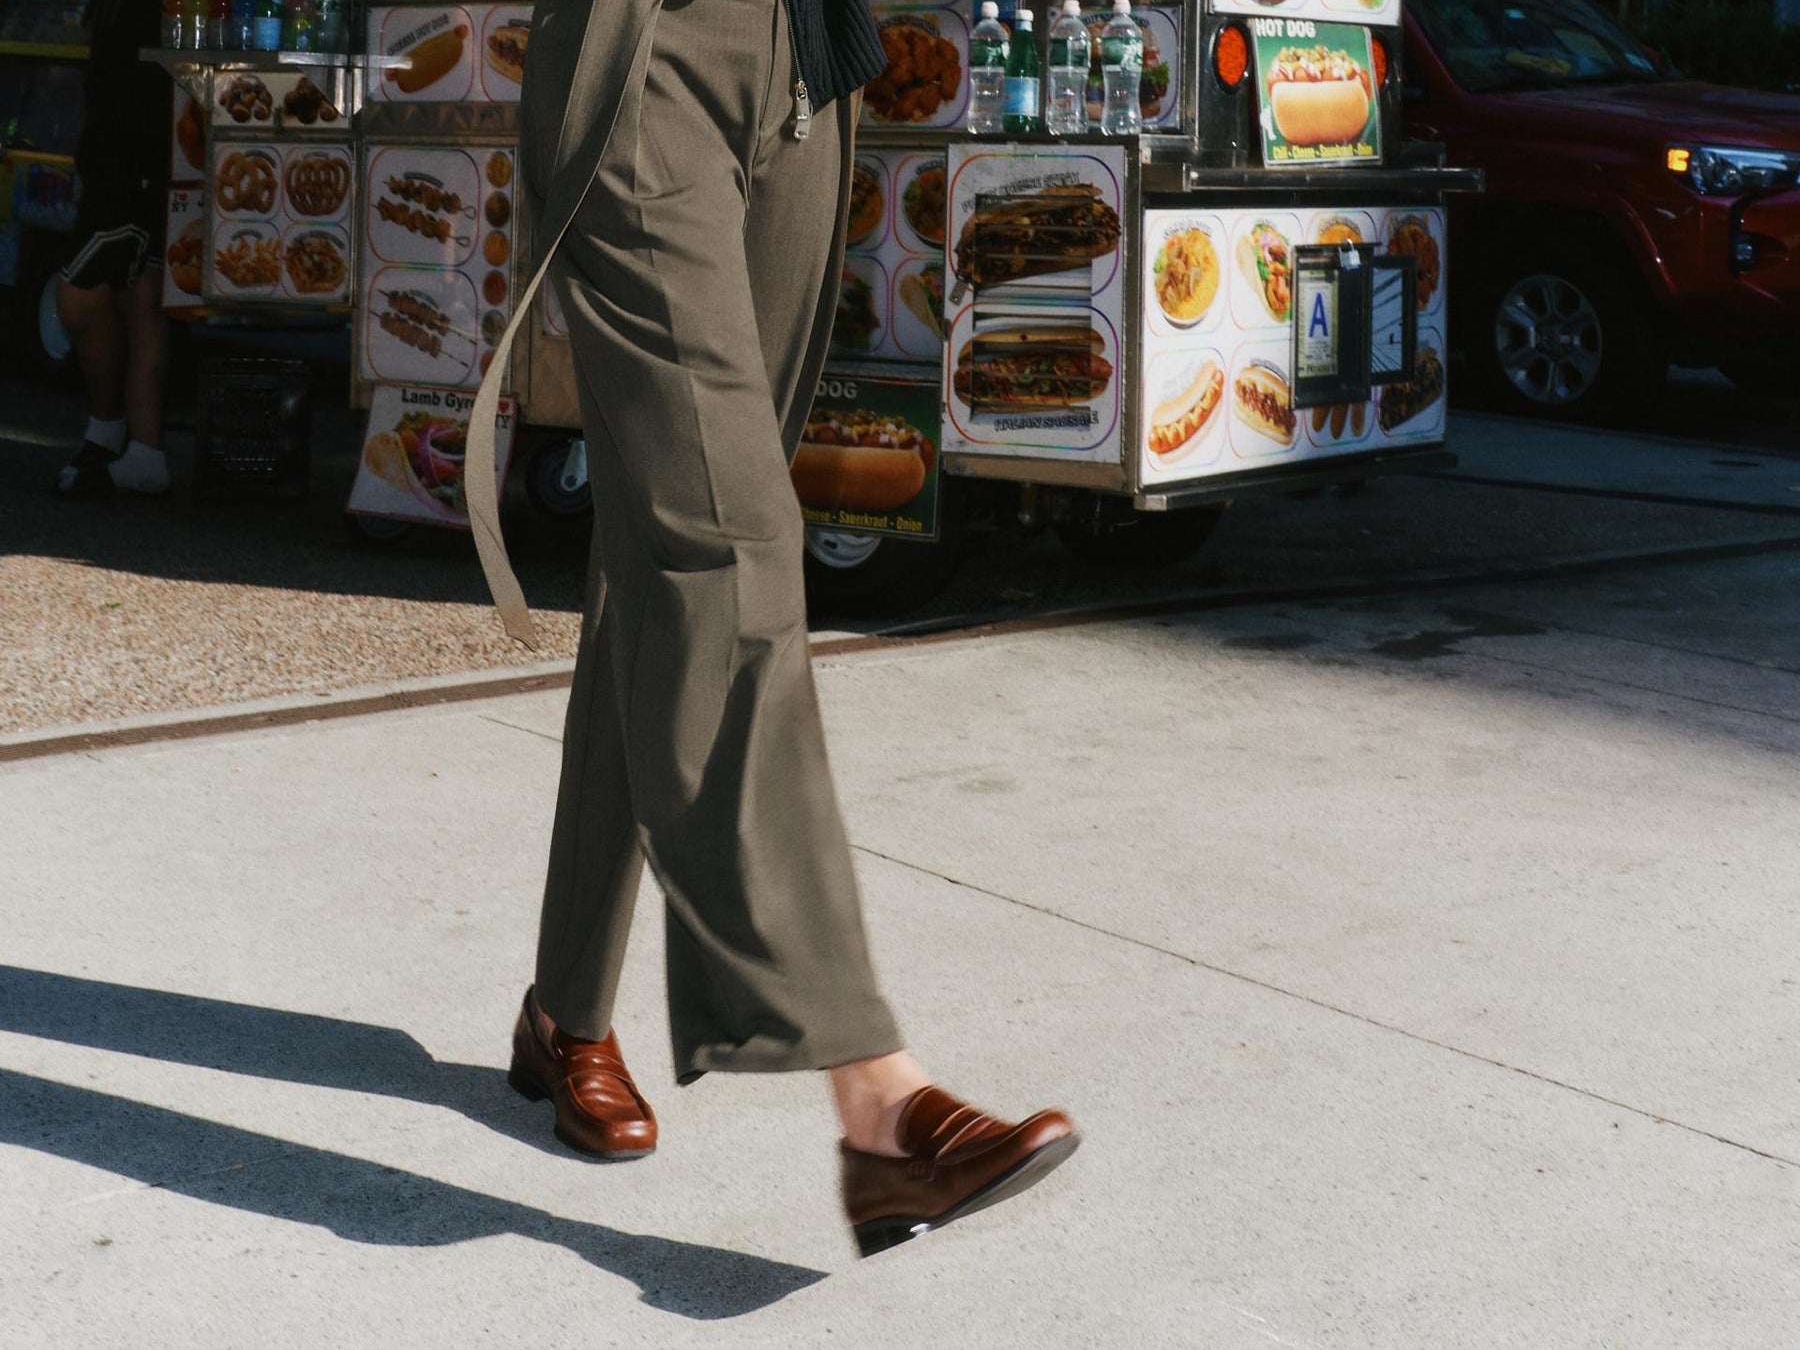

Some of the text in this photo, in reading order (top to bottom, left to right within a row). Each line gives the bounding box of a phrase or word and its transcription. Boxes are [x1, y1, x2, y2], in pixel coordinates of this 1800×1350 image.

[1255, 18, 1316, 38] HOT DOG
[1308, 292, 1329, 338] A
[401, 389, 440, 405] Lamb
[839, 510, 888, 528] Sauerkraut
[896, 516, 923, 532] Onion
